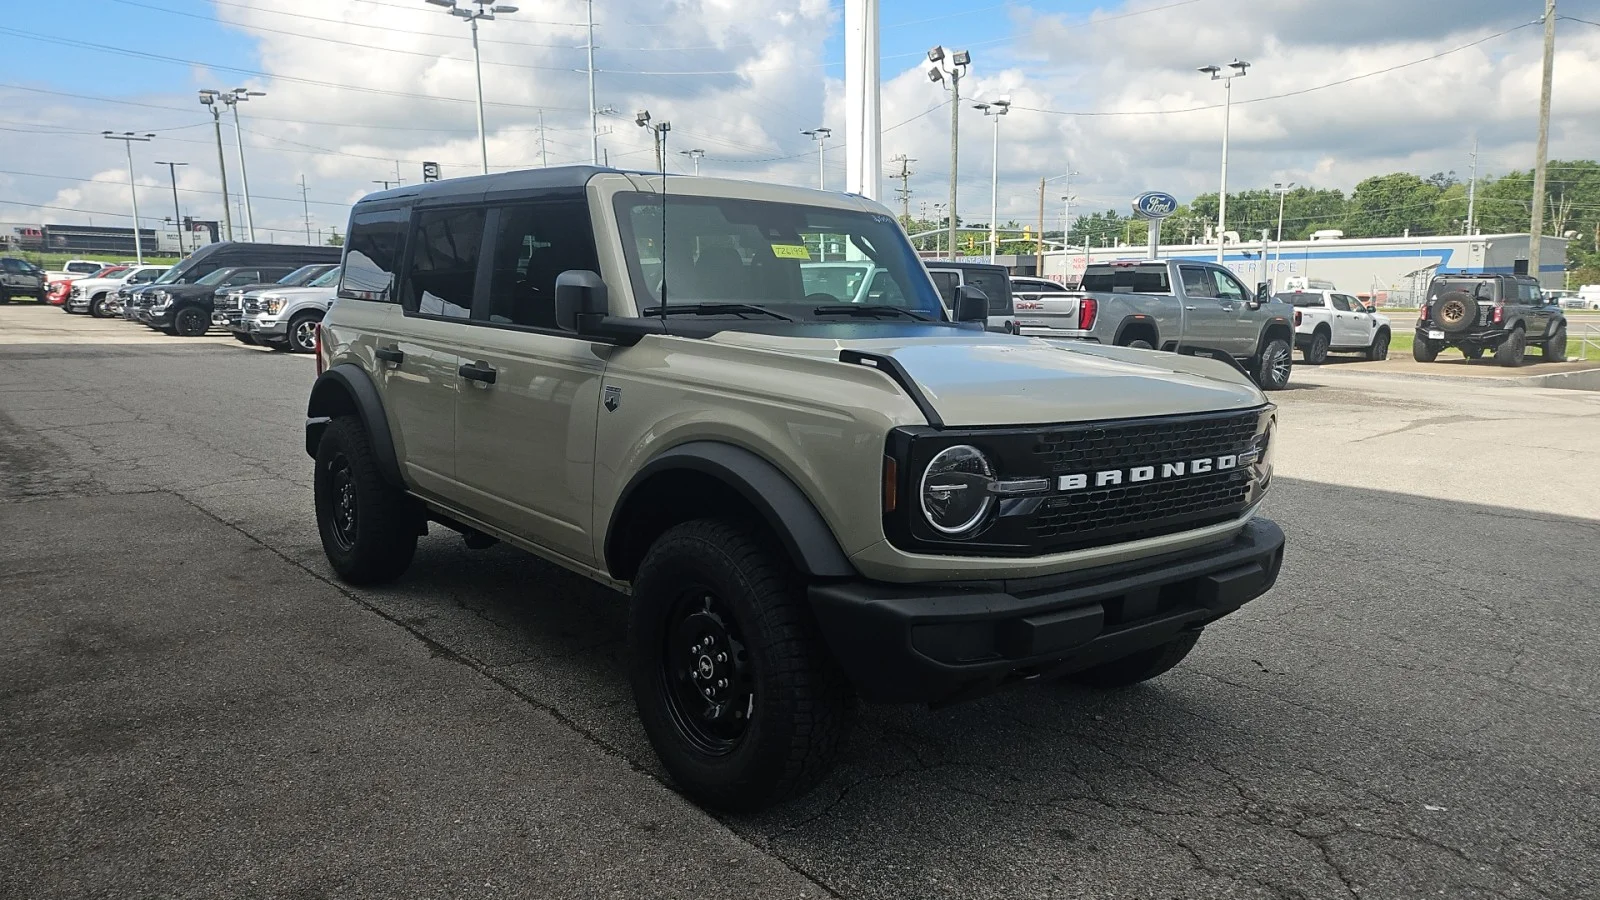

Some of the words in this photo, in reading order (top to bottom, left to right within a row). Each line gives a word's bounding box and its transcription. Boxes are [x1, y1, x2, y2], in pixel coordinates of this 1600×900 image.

[1147, 196, 1171, 213] Ford
[1227, 262, 1297, 274] SERICE
[1058, 455, 1237, 491] BRONCO
